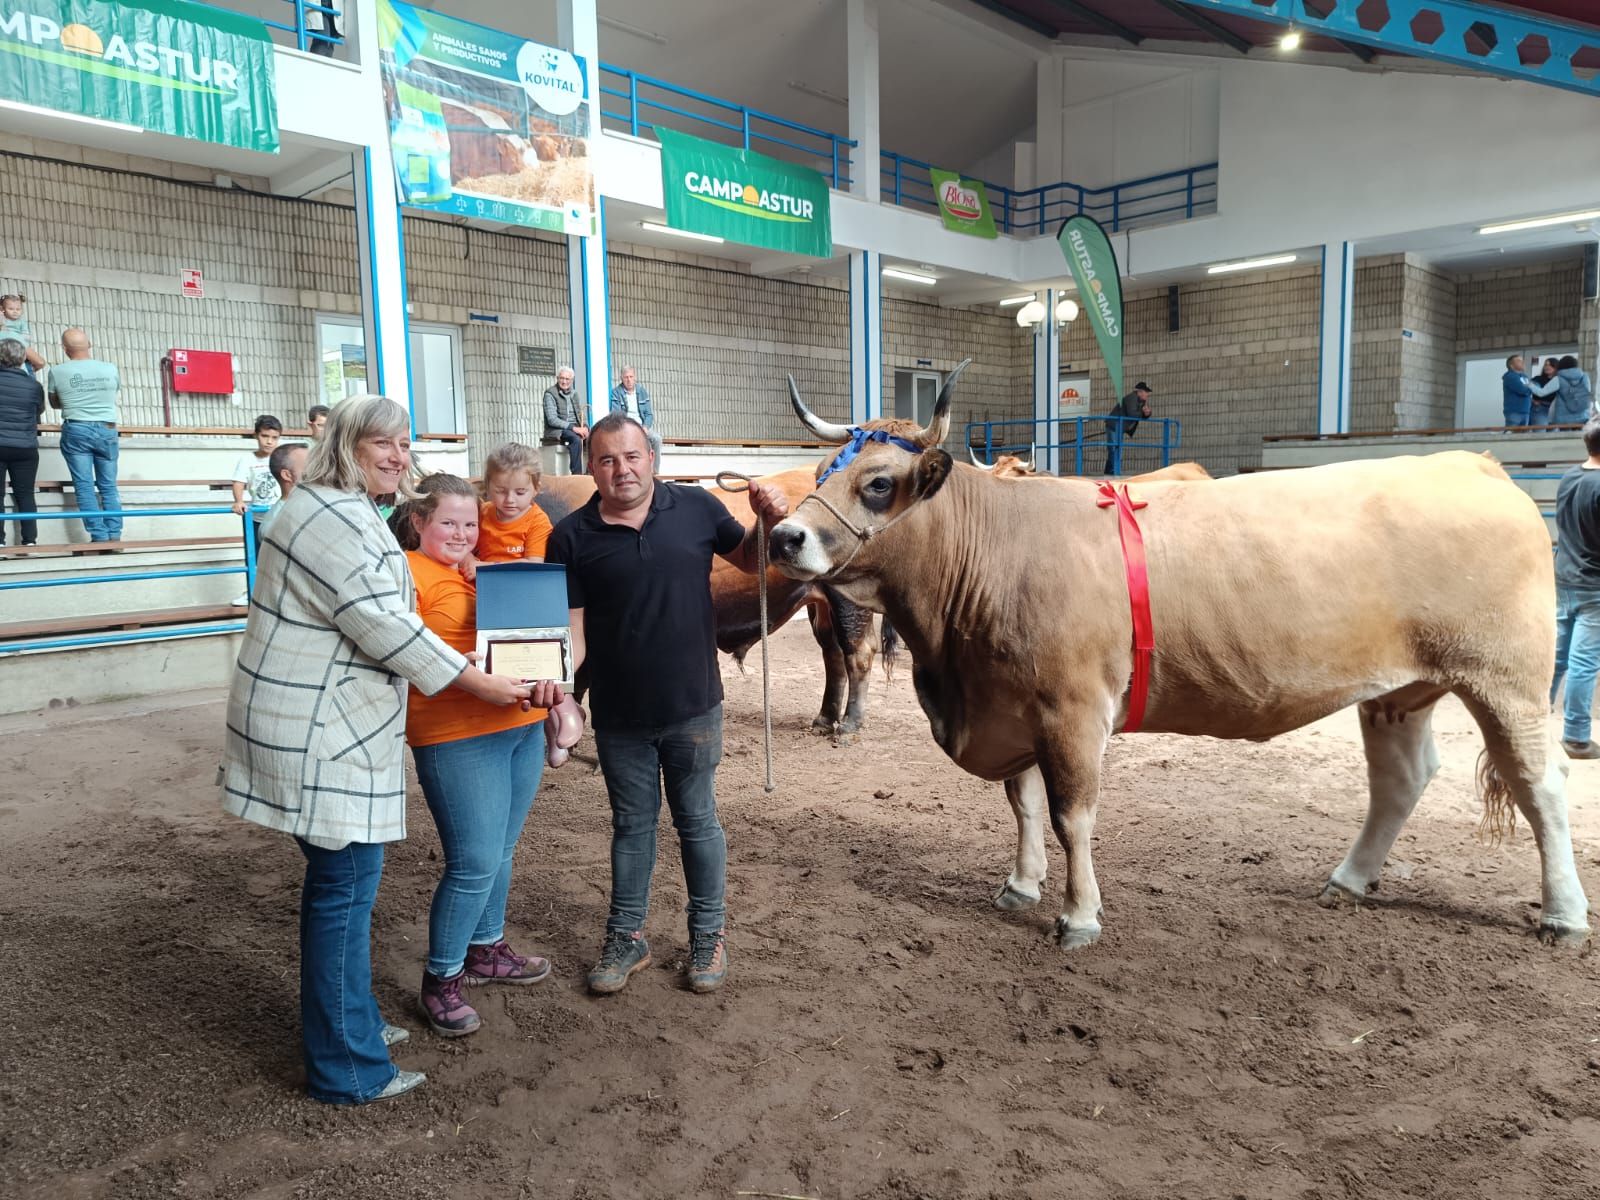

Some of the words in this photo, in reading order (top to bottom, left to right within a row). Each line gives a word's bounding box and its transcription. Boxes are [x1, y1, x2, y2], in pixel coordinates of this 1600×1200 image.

[433, 32, 477, 52] ANIMALES
[478, 46, 507, 61] SANOS
[433, 42, 440, 51] Y
[441, 43, 501, 68] PRODUCTIVOS
[525, 72, 576, 93] KOVITAL
